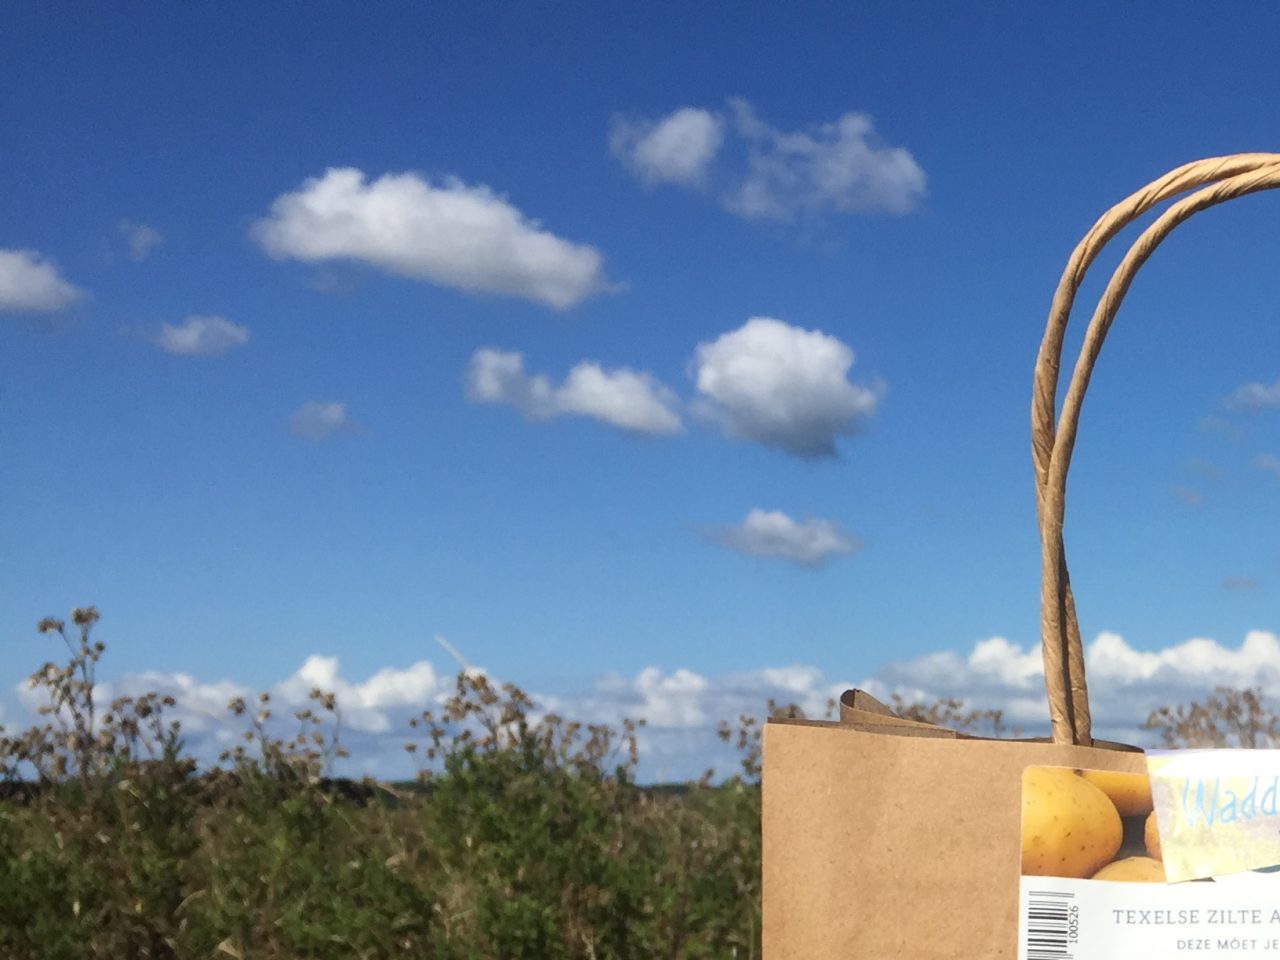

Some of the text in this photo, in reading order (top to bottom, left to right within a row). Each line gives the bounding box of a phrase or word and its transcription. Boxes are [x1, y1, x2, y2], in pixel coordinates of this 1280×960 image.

[1068, 905, 1079, 944] 100526
[1113, 909, 1200, 925] TEXELSE
[1208, 908, 1263, 924] ZILTE
[1177, 939, 1211, 950] DEZE
[1264, 939, 1279, 949] JE
